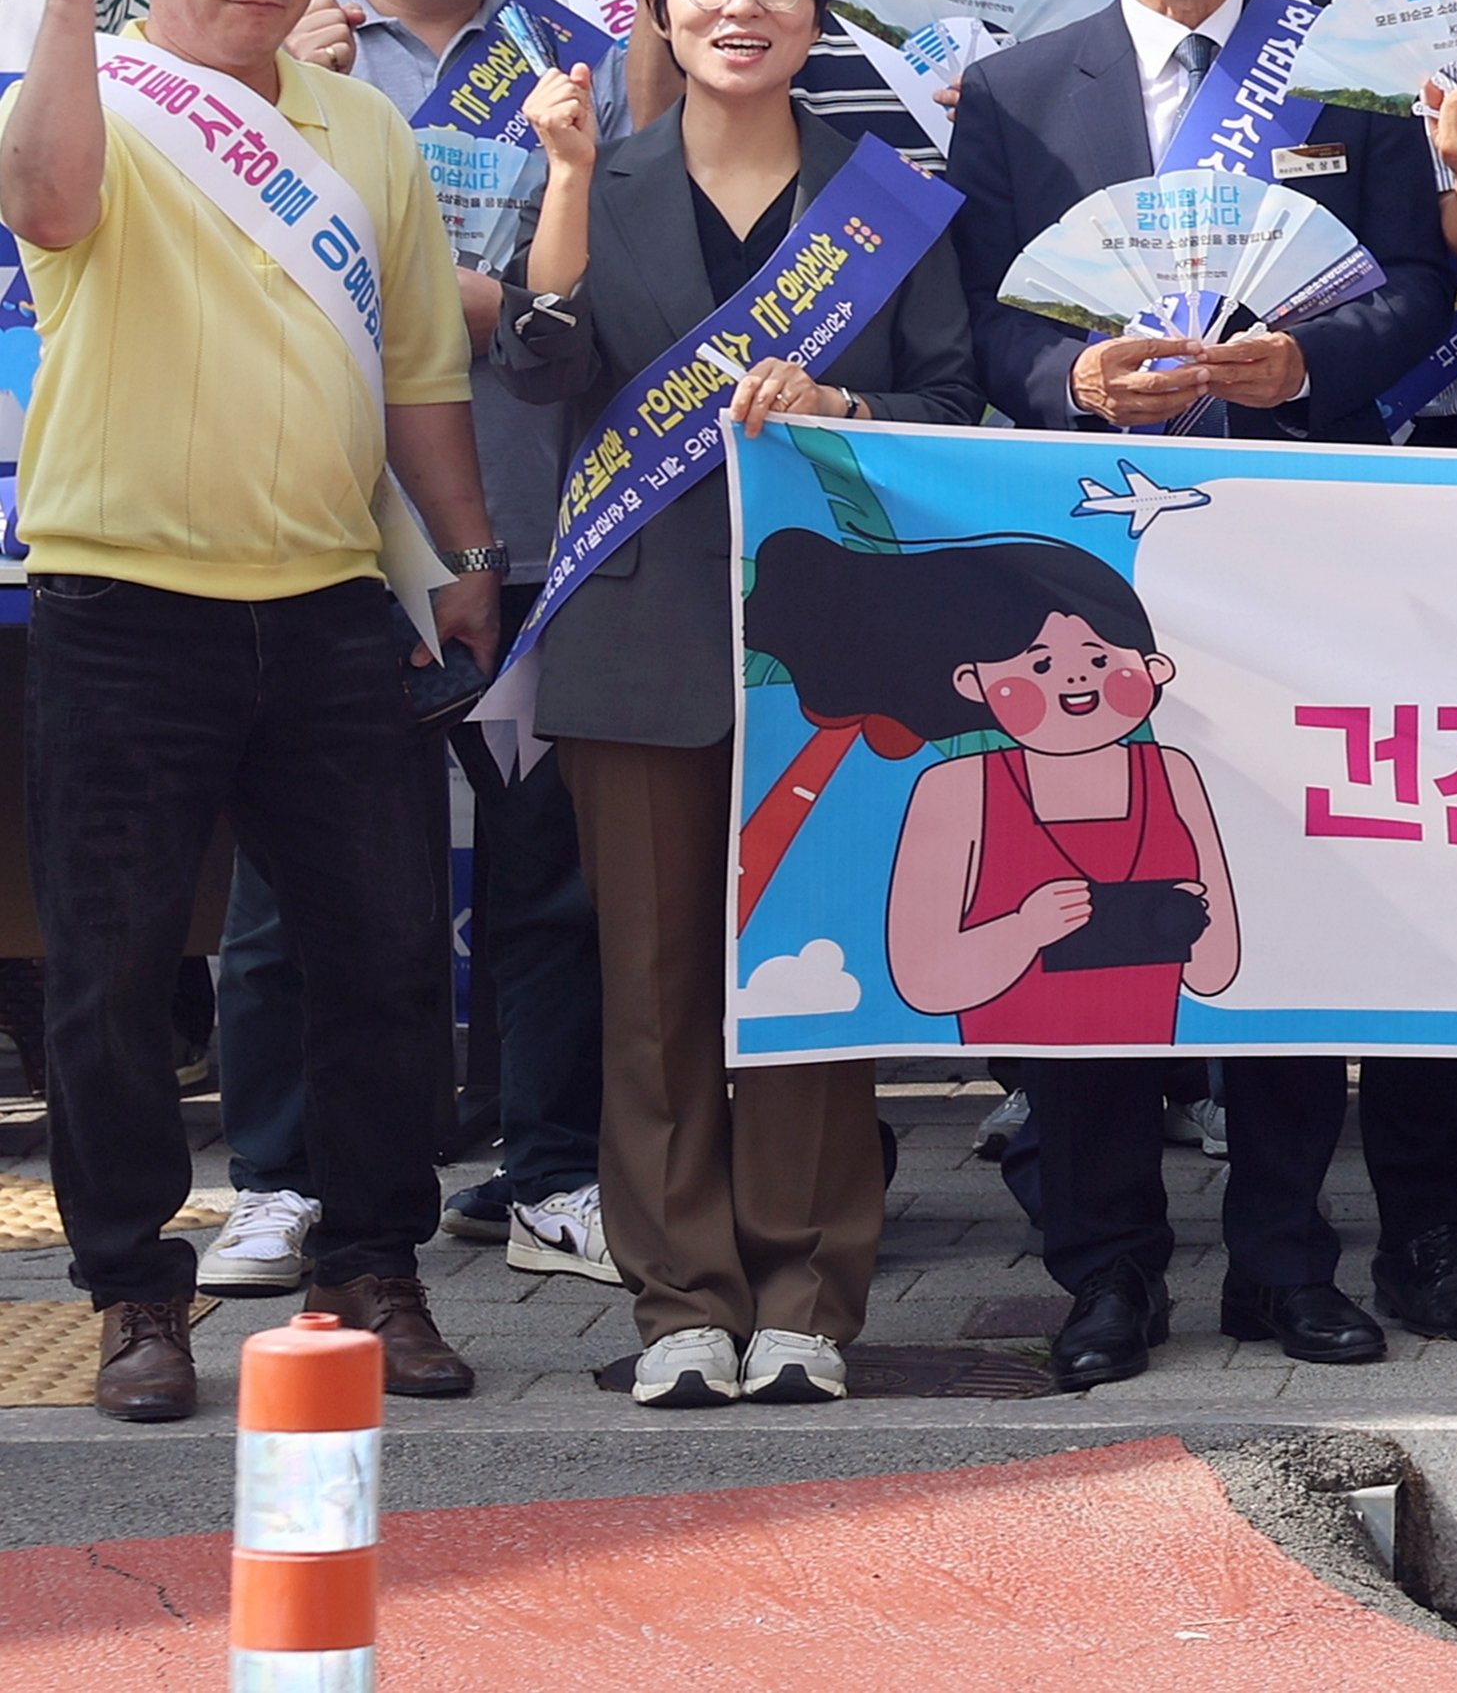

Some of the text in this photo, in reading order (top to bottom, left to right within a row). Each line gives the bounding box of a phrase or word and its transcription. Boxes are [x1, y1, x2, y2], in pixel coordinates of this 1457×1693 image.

[97, 54, 319, 228] 전통시장을
[1135, 186, 1240, 210] 함께합시다
[1136, 206, 1241, 232] 같이삽시다
[749, 232, 849, 339] 성장하는
[573, 487, 643, 562] 화순경제도
